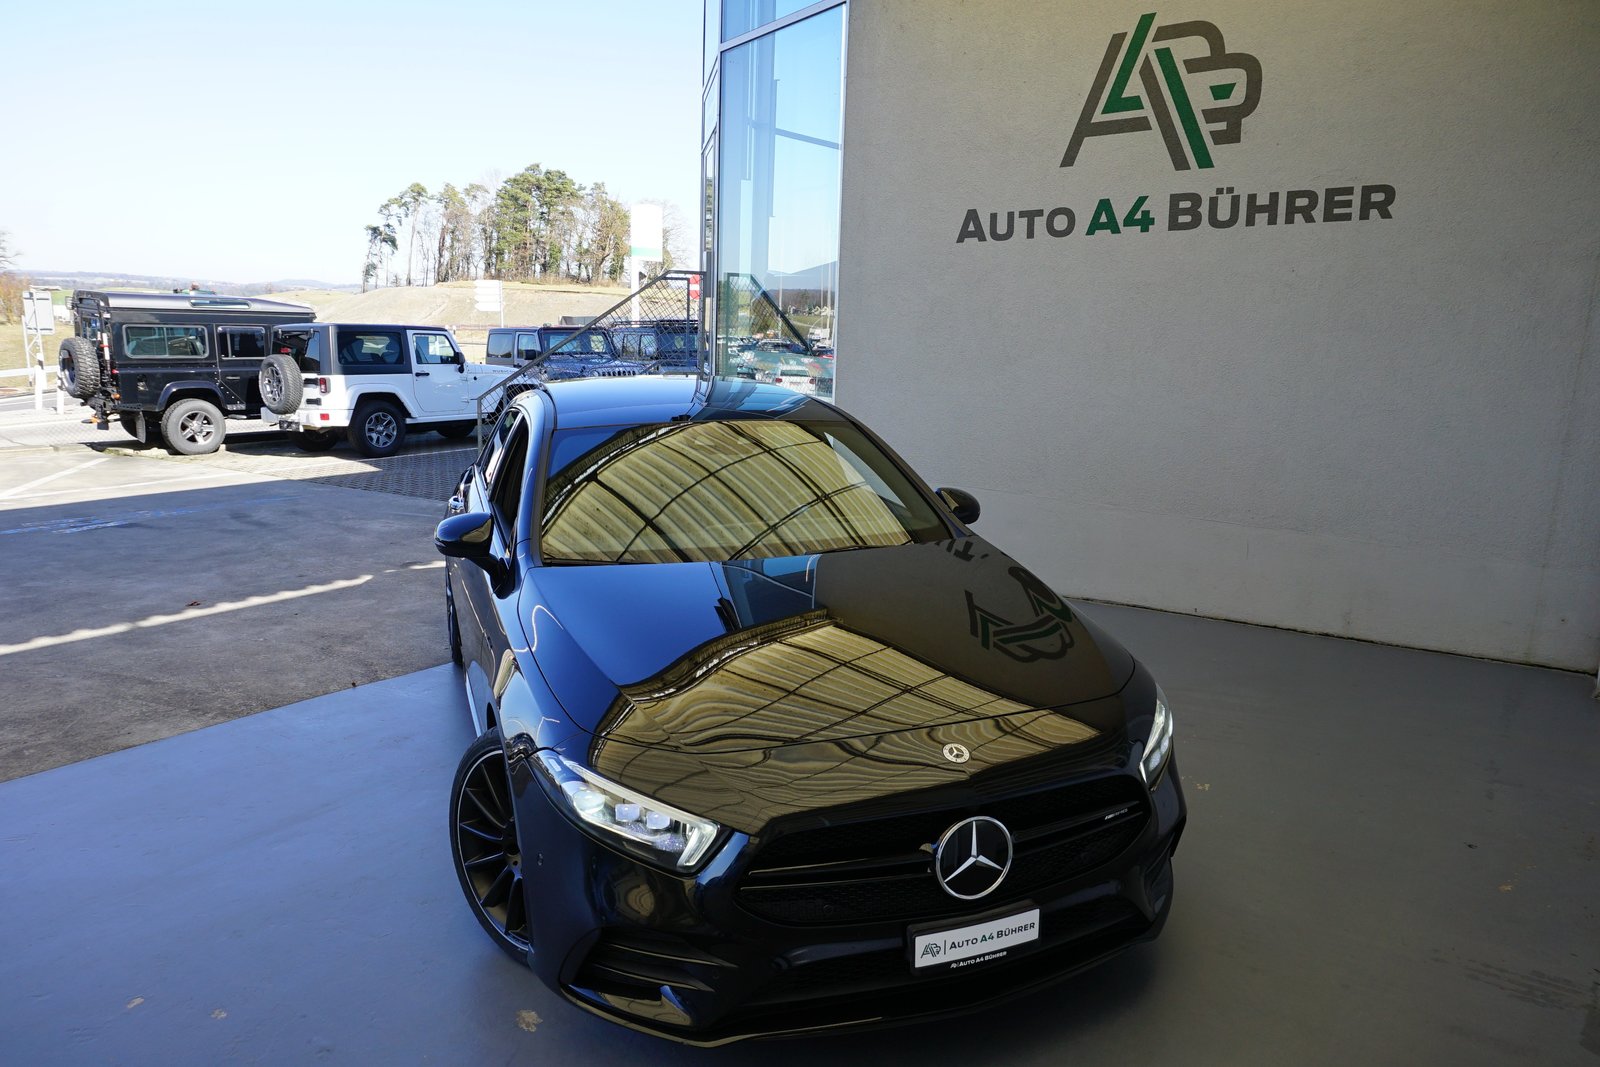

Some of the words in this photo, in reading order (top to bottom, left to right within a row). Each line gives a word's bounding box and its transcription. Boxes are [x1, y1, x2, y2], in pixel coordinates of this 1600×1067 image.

[956, 207, 1076, 243] AUTO
[1085, 195, 1155, 236] A4
[1167, 184, 1396, 231] BÜHRER
[949, 938, 978, 950] AUTO
[980, 932, 994, 943] A4
[996, 922, 1035, 938] BÜHRER
[959, 959, 975, 967] AUTO
